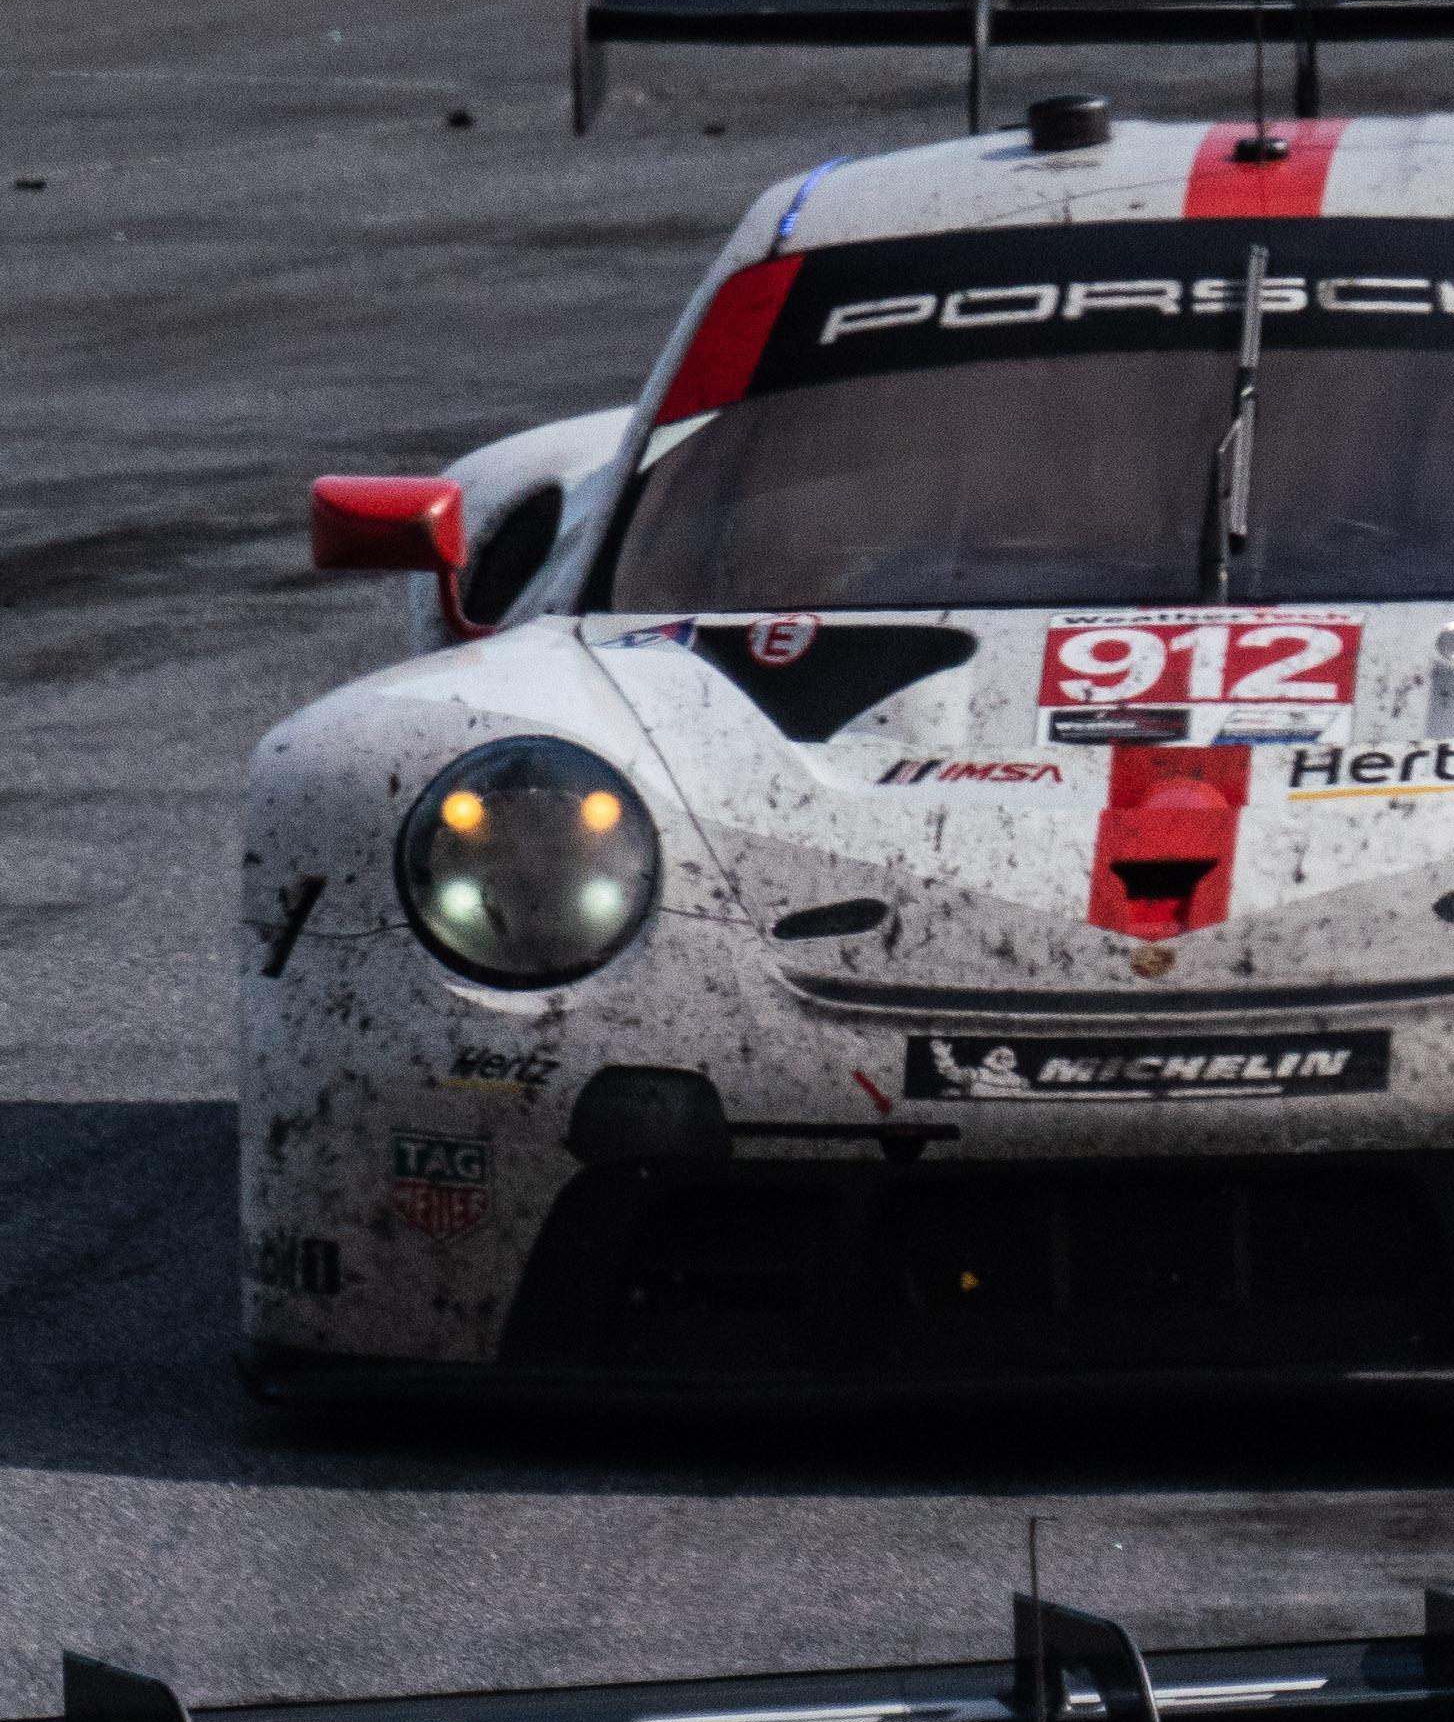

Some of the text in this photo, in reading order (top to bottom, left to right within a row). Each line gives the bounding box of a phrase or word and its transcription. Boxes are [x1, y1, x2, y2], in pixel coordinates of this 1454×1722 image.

[1058, 627, 1343, 702] 912
[936, 760, 1064, 785] IMSA
[450, 1045, 559, 1086] Hertz
[1036, 1047, 1354, 1085] MICHELIN
[399, 1140, 482, 1179] TAG
